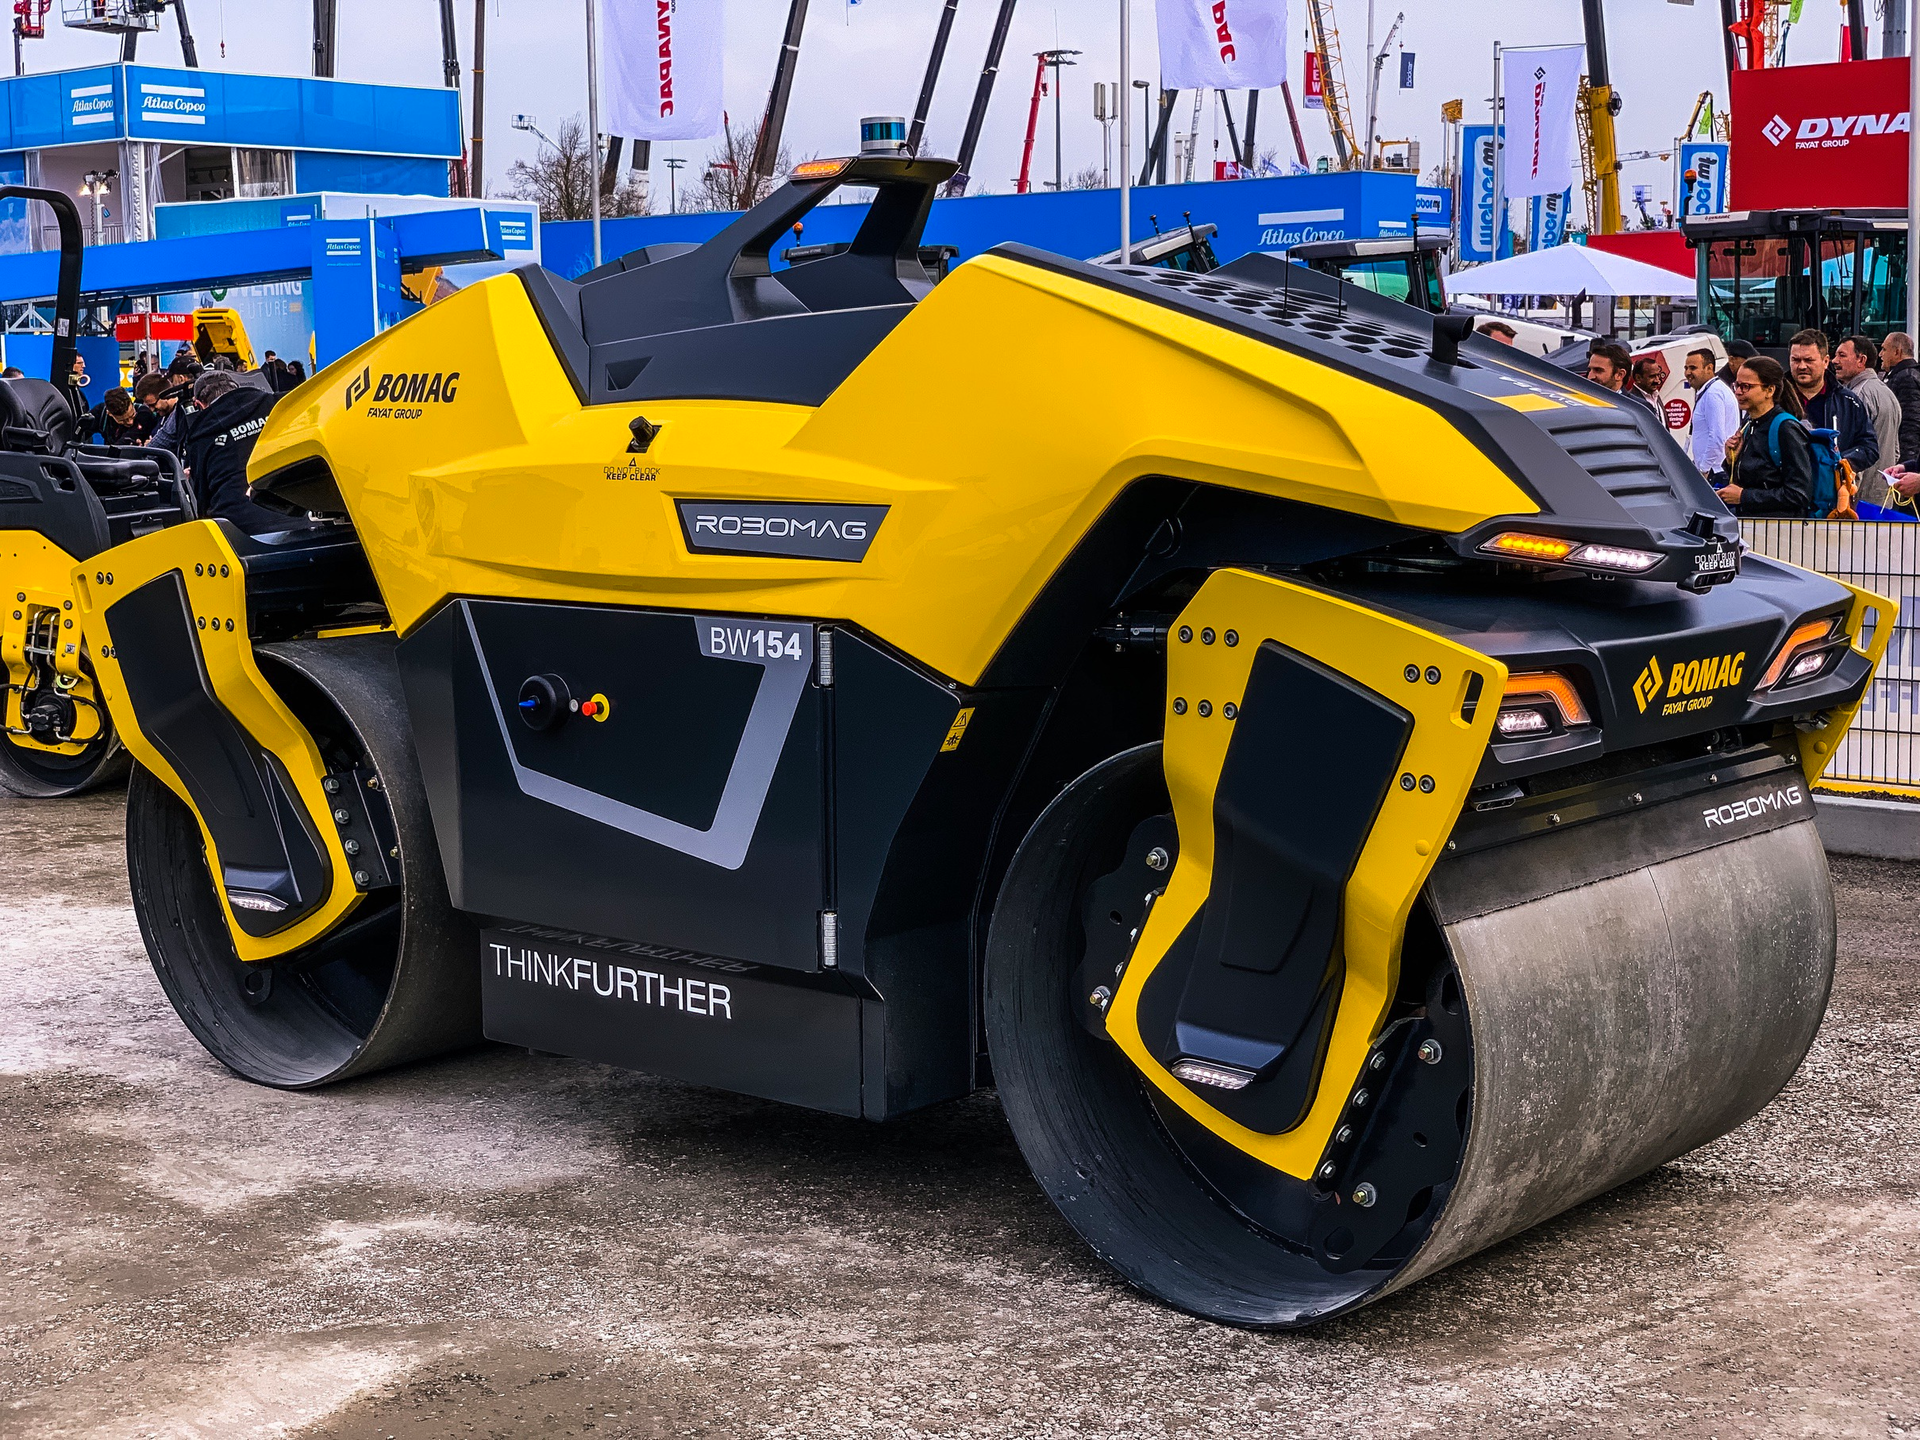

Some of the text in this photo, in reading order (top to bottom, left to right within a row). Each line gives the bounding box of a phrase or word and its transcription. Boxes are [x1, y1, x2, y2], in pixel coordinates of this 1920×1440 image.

[72, 98, 113, 112] Atlas Copco
[141, 96, 206, 113] Atlas Copco
[1795, 140, 1850, 149] FAYAT GROUP
[1258, 228, 1300, 246] Atlas
[129, 315, 139, 323] 1108
[151, 315, 169, 323] Block
[373, 372, 460, 403] BOMAG
[367, 408, 422, 419] FAYAT GROUP
[635, 467, 661, 475] BLOCK
[696, 515, 867, 540] ROBOMAG
[1695, 551, 1736, 564] DO NOT BLOCK
[1699, 560, 1735, 571] KEEP CLEAR
[710, 627, 802, 661] BW154
[1666, 651, 1745, 698] BOMAG
[1661, 696, 1713, 716] FAYAT GROUP
[1703, 786, 1802, 828] ROBOMAG
[489, 943, 731, 1020] THINKFURTHER
